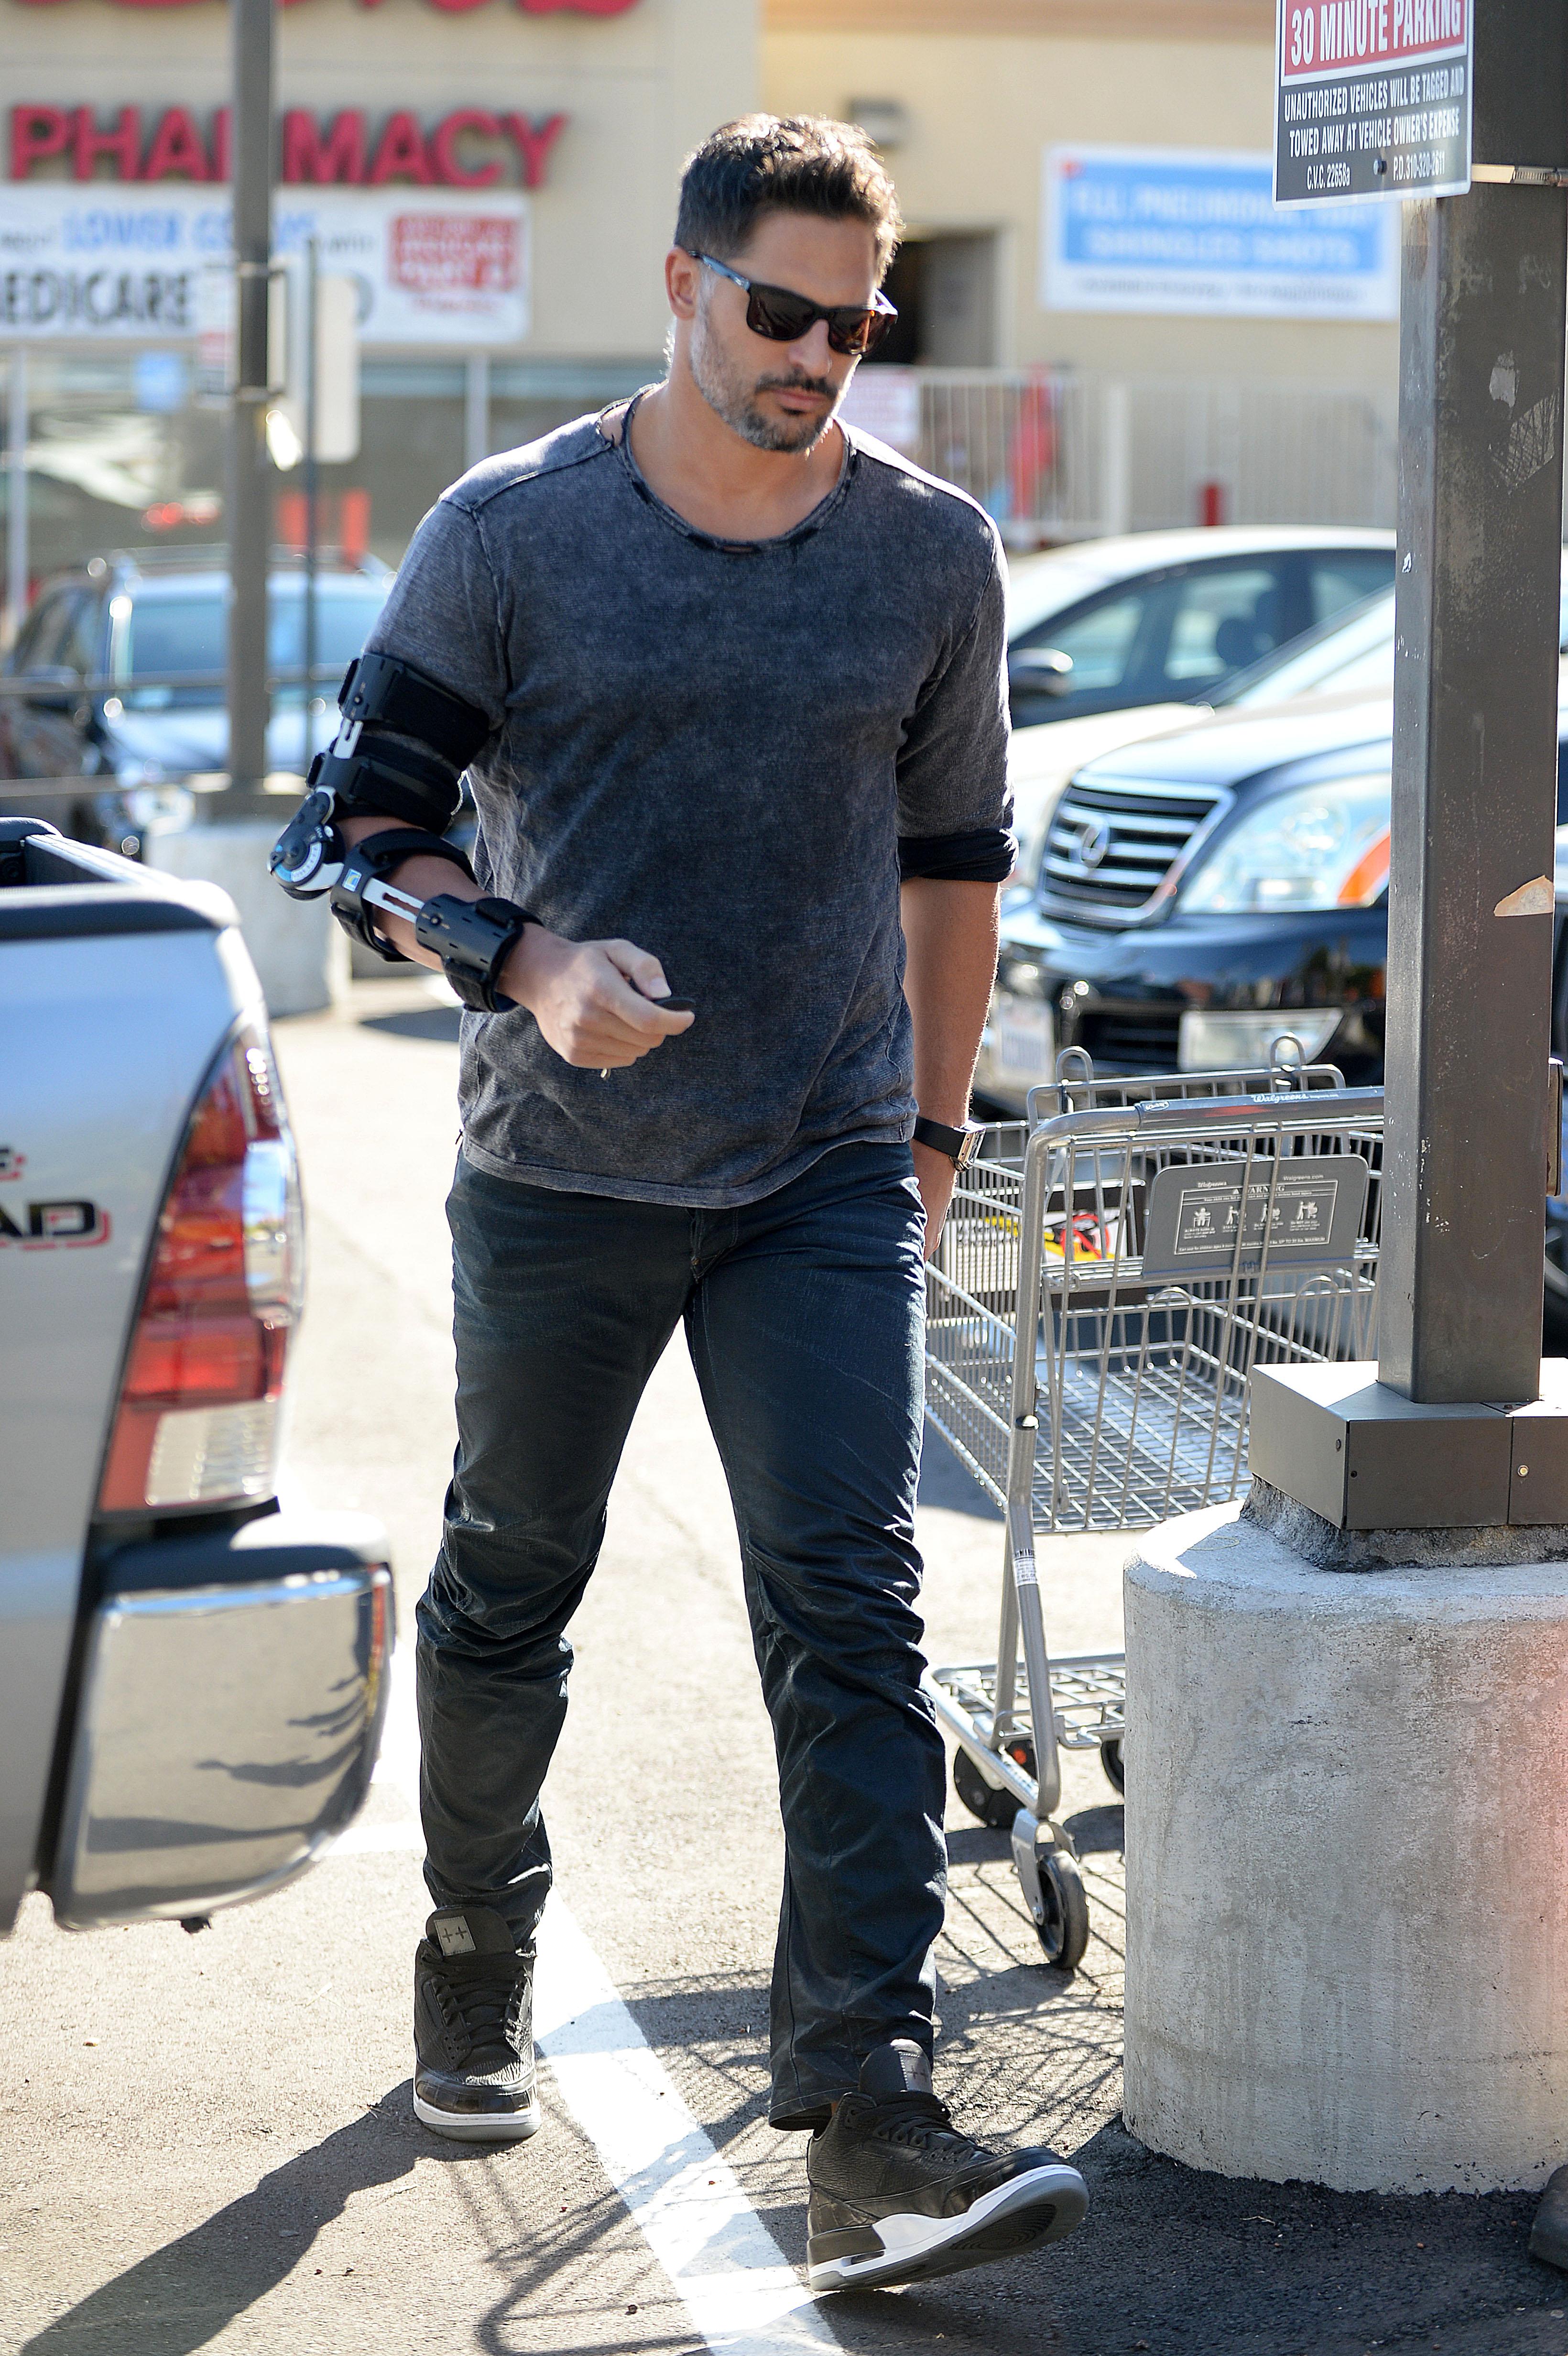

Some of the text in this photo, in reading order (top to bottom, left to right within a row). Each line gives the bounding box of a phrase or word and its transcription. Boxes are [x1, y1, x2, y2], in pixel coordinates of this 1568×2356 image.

[1291, 0, 1461, 66] 30 MINUTE PARKING
[1285, 65, 1464, 122] UNAUTHORIZED VEHICLES WILL BE TAGGED AND
[1289, 106, 1459, 157] TOWED AWAY AT VEHICLE OWNER'S EXPENSE
[1307, 162, 1350, 190] C.V.C. 22658a
[0, 268, 190, 327] EDICARE
[1251, 1094, 1309, 1103] Walgreens
[1248, 1185, 1285, 1194] ARNG
